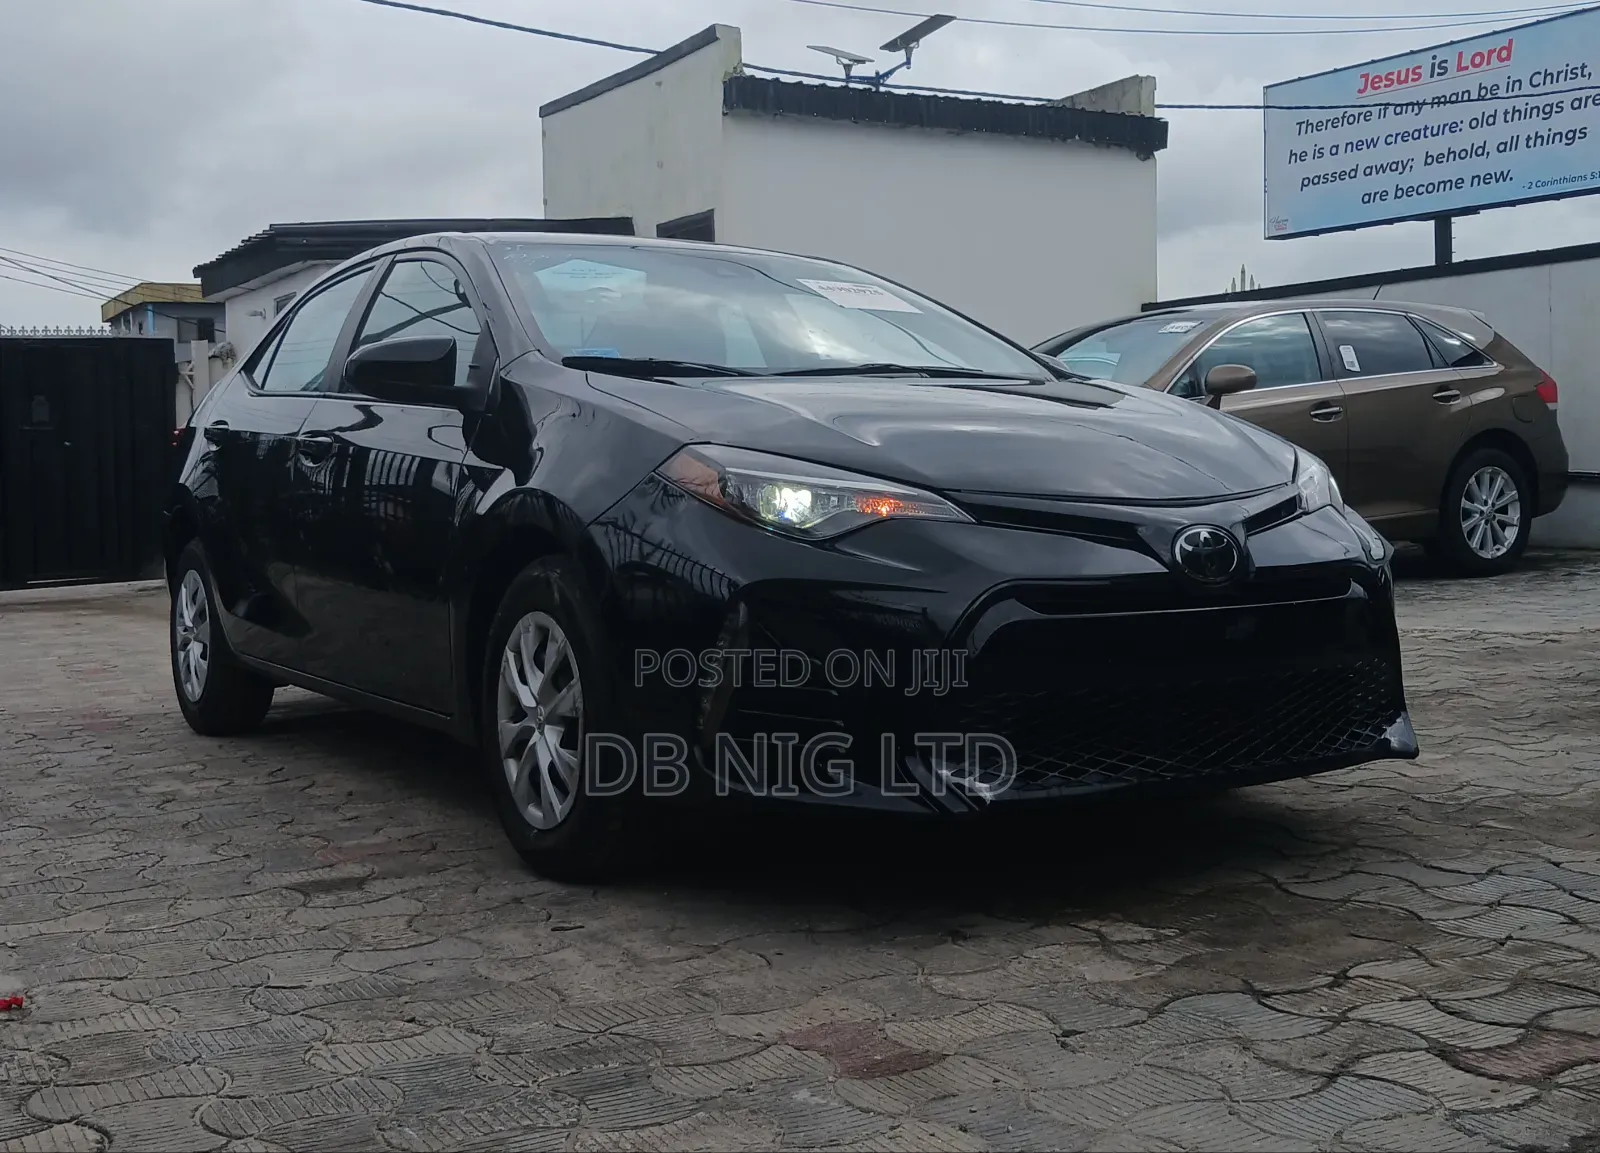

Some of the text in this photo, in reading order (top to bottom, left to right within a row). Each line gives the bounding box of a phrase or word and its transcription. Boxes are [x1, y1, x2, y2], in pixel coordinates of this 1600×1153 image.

[1357, 38, 1513, 94] Jesus is Lord
[1288, 93, 1600, 165] he is a new creature: old things are
[1296, 110, 1373, 136] Therefore
[1393, 98, 1426, 116] any
[1431, 89, 1471, 109] man
[1478, 82, 1500, 99] be
[1505, 75, 1523, 93] in
[1529, 62, 1592, 88] Christ,
[1300, 126, 1588, 192] passed away; behold, all things
[1361, 169, 1514, 205] are become new.
[1535, 174, 1588, 188] Corinthians
